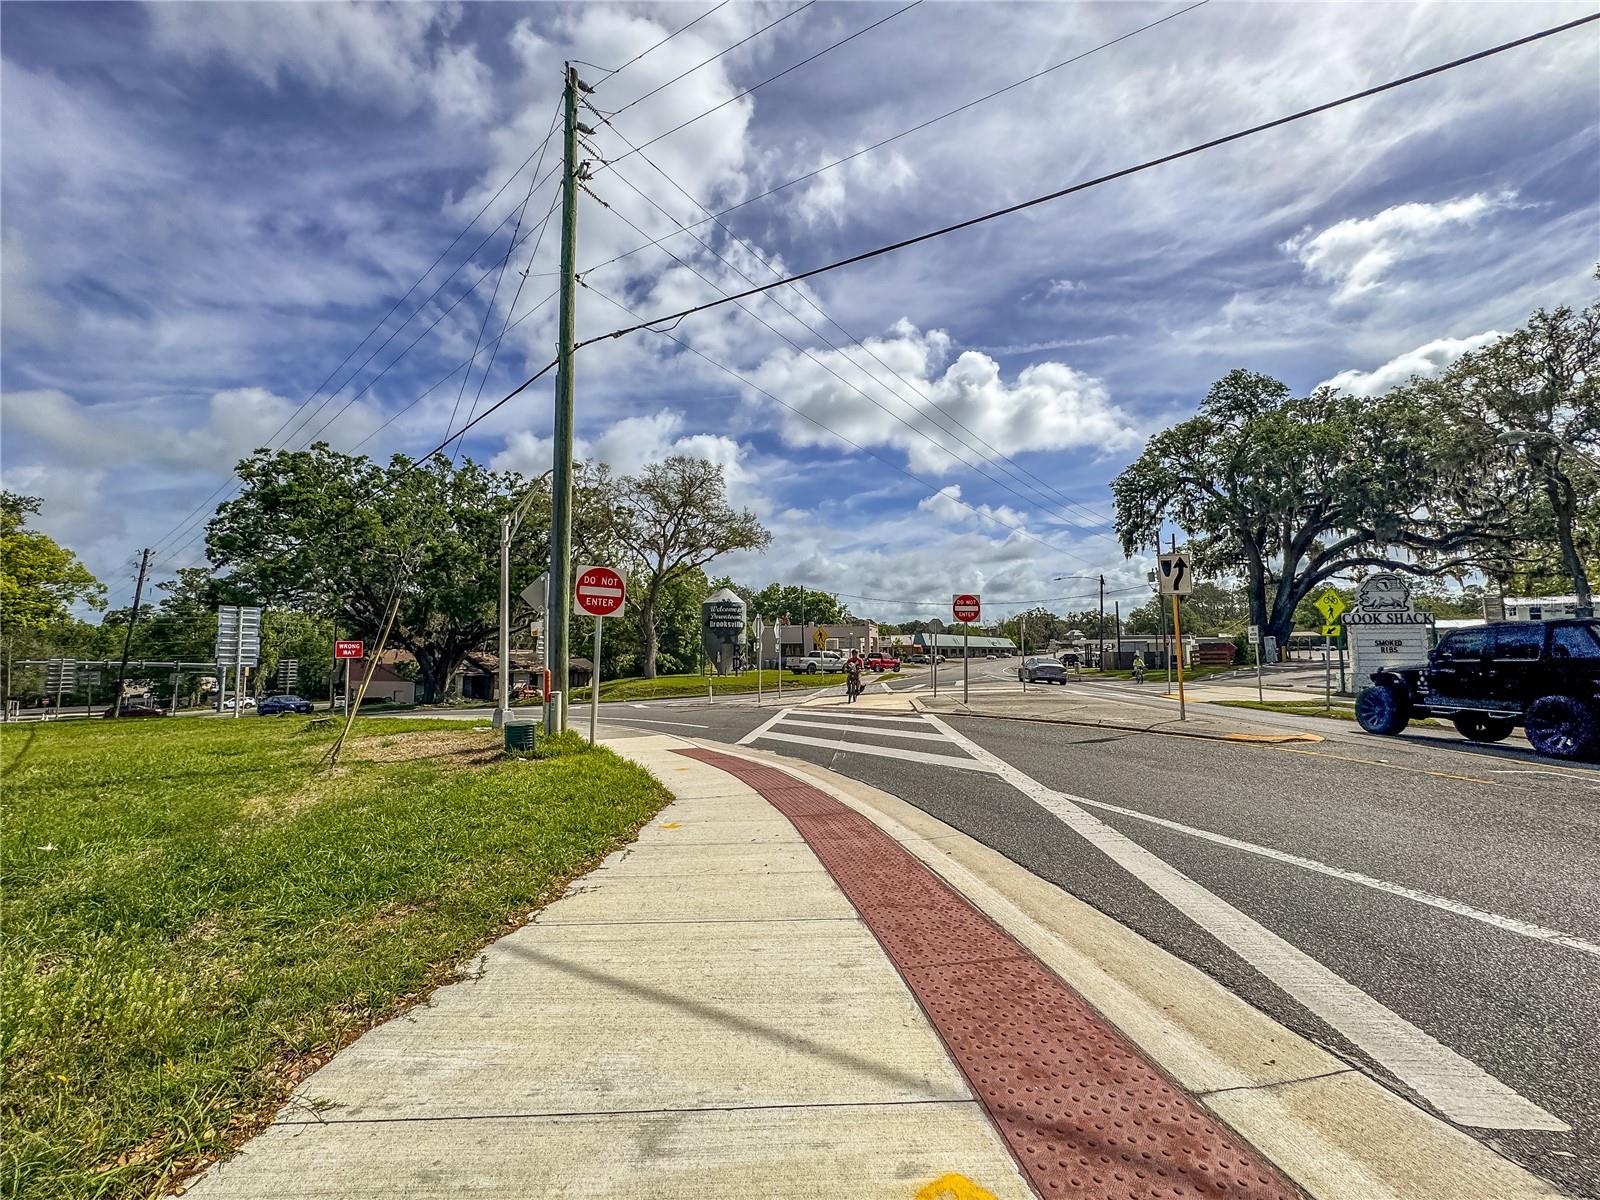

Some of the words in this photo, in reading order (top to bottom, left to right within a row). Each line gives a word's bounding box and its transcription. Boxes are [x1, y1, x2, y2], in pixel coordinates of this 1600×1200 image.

[583, 575, 596, 585] DO
[601, 577, 619, 586] NOT
[586, 597, 614, 607] ENTER
[1342, 613, 1382, 624] COOK
[1387, 613, 1432, 624] SHACK
